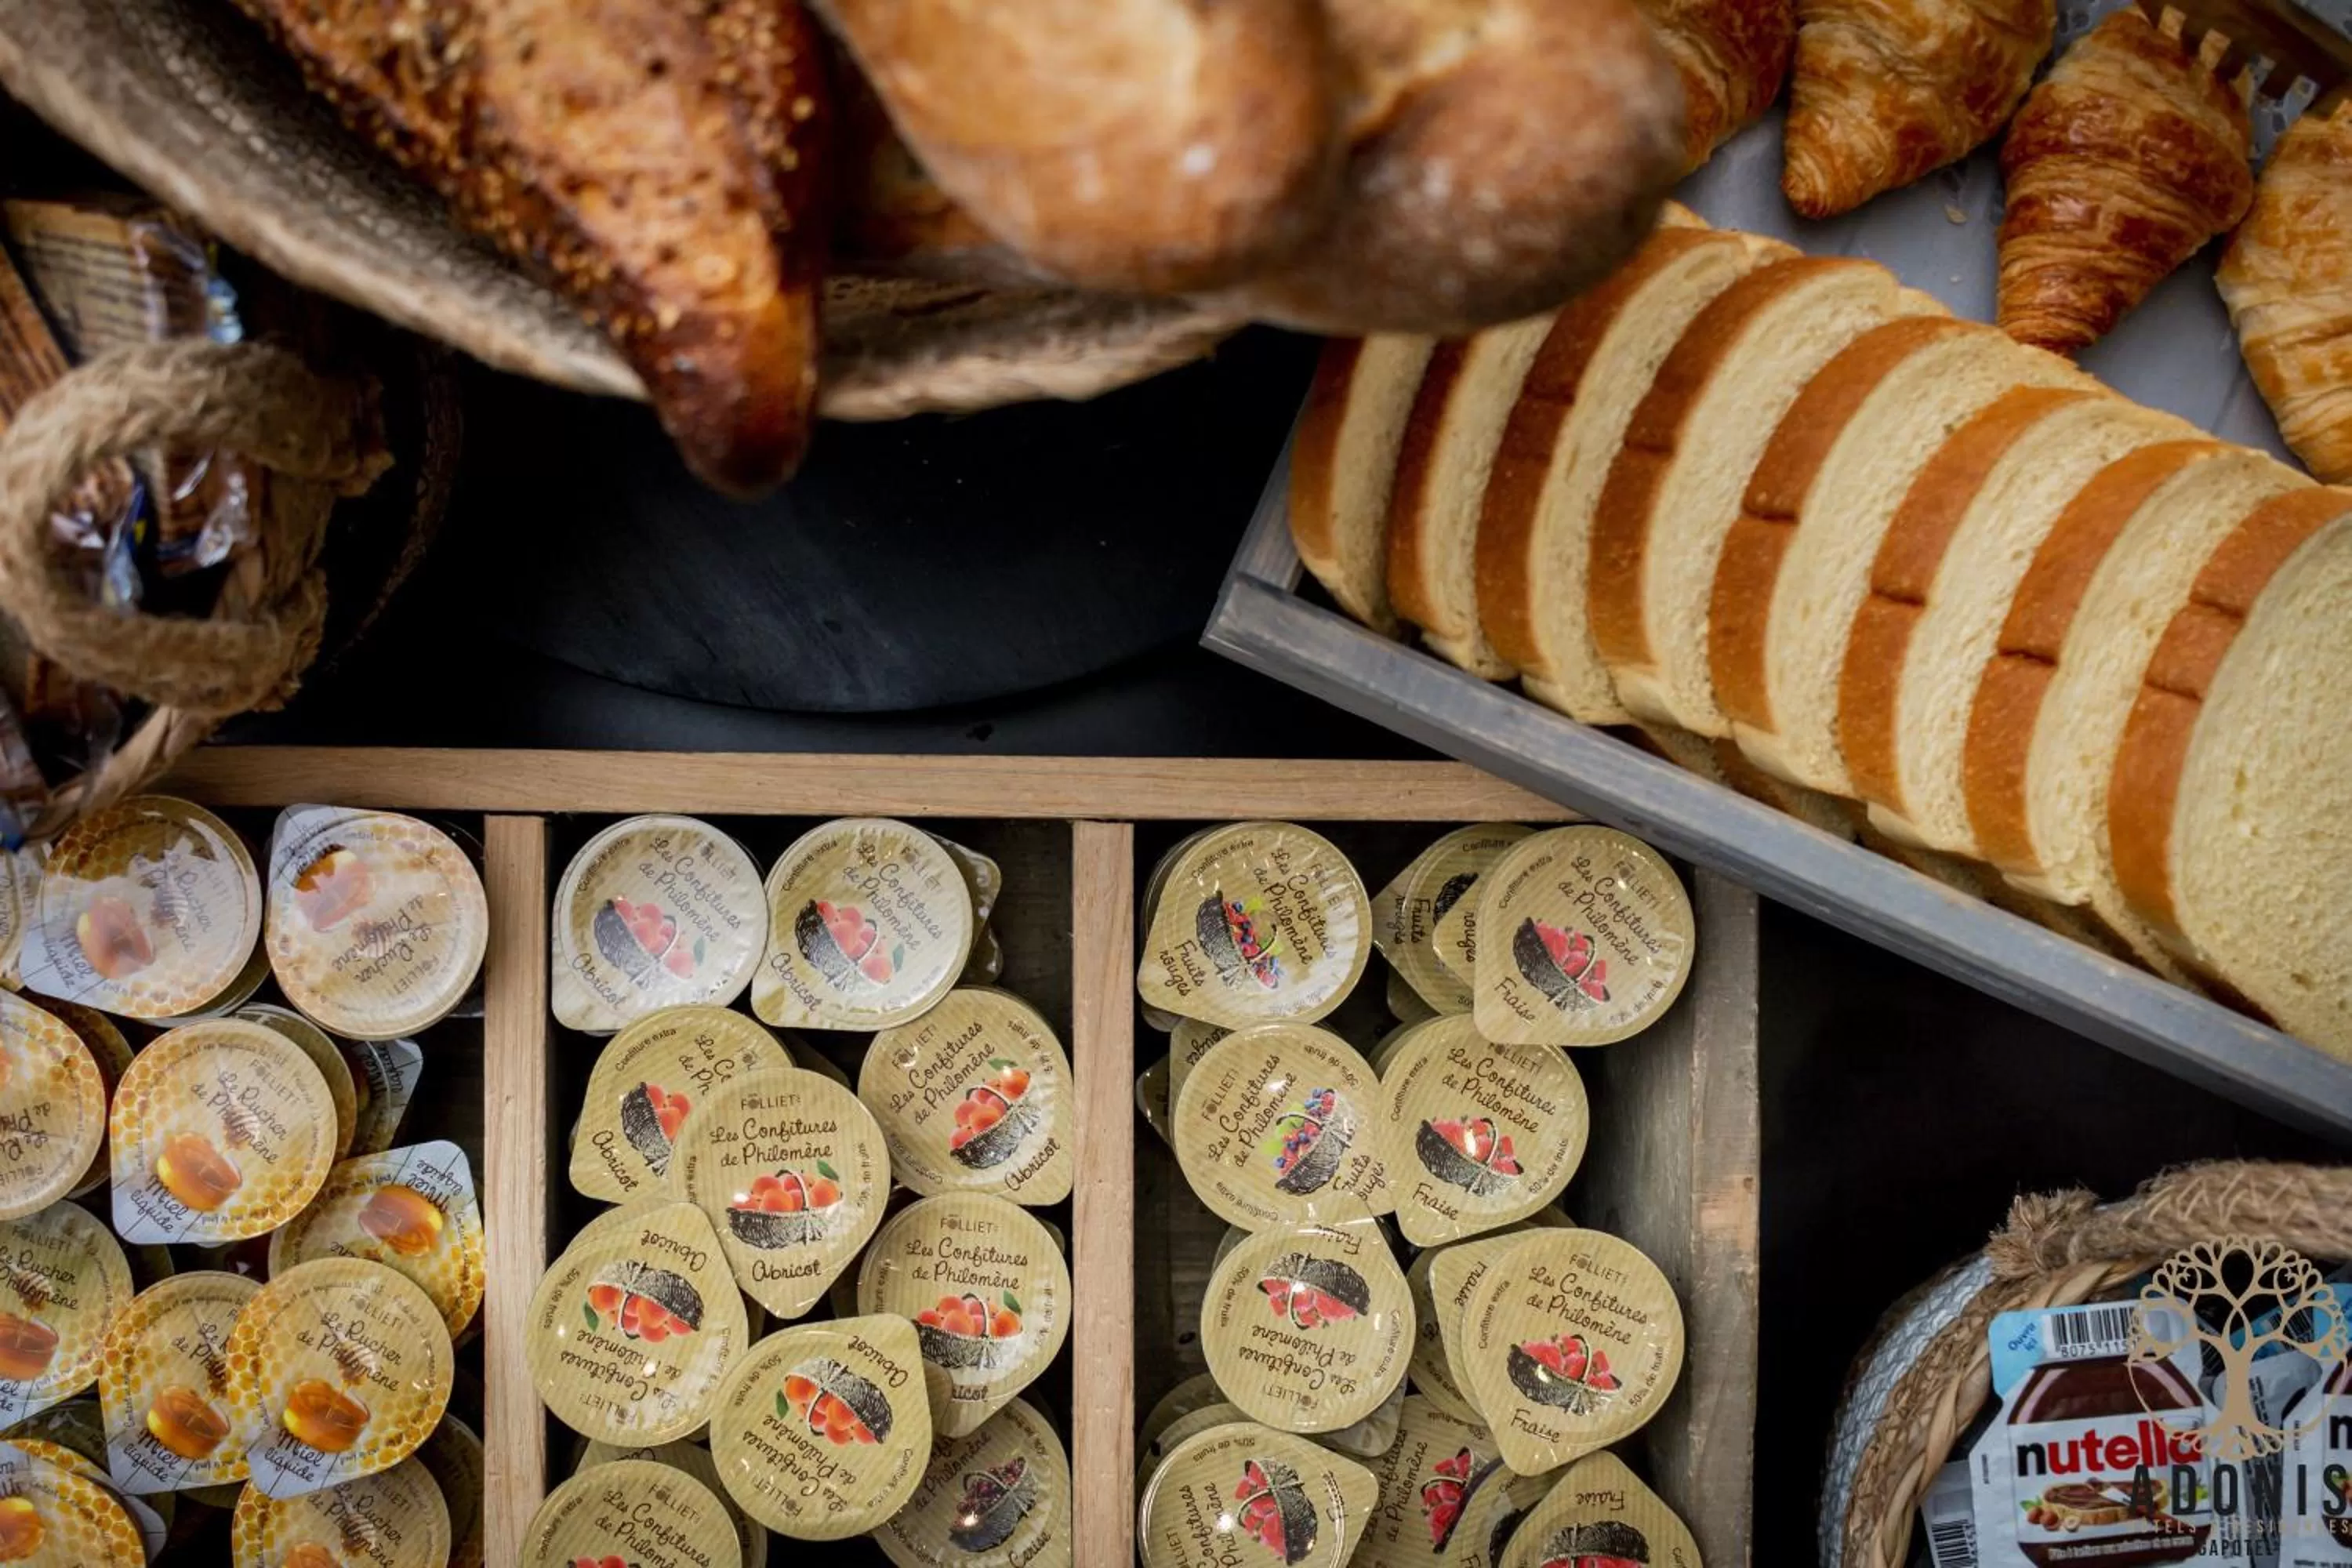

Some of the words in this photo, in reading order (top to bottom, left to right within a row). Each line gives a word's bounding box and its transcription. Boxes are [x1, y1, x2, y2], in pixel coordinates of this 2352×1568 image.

[1270, 847, 1292, 877] Les
[1498, 870, 1529, 909] Confiture
[1529, 855, 1554, 873] extra
[638, 862, 654, 879] de
[653, 869, 720, 942] Philomène
[650, 837, 673, 864] Les
[674, 856, 741, 930] Confitures
[856, 840, 879, 869] Les
[878, 862, 942, 941] Confitures
[1613, 859, 1654, 907] FOLLIET
[857, 875, 922, 951] Philomène
[1253, 866, 1268, 885] de
[1263, 881, 1314, 965] Philomène
[1557, 881, 1573, 898] de
[1573, 890, 1639, 966] Philomène
[1570, 855, 1593, 884] Les
[1593, 877, 1662, 955] Confitures
[1457, 910, 1477, 964] rouges
[354, 939, 415, 983] Rucher
[572, 952, 629, 1011] Abricot
[1160, 949, 1192, 999] rouges
[1174, 938, 1206, 988] Fruits
[771, 952, 822, 1014] Abricot
[1494, 976, 1538, 1022] Fraise
[615, 1037, 652, 1073] Confiture
[652, 1027, 677, 1044] extra
[678, 1054, 695, 1073] de
[694, 1032, 717, 1062] Les
[890, 1088, 915, 1115] Les
[908, 1020, 984, 1090] Confitures
[1303, 1043, 1327, 1062] fruits
[1327, 1057, 1341, 1068] de
[191, 1083, 208, 1101] de
[740, 1093, 793, 1111] FOLLIET
[914, 1108, 931, 1126] de
[924, 1042, 996, 1111] Philomène
[1203, 1069, 1236, 1121] FOLLIET
[1390, 1077, 1411, 1123] Confiture
[1410, 1057, 1429, 1079] extra
[1446, 1047, 1473, 1070] Les
[1475, 1058, 1556, 1117] Confitures
[237, 1086, 288, 1142] Rucher
[1207, 1137, 1231, 1163] Les
[1219, 1054, 1281, 1133] Confitures
[1237, 1071, 1298, 1149] Philomène
[1441, 1073, 1458, 1091] de
[1460, 1077, 1539, 1134] Philomène
[709, 1125, 741, 1147] Les
[742, 1117, 839, 1142] Confitures
[591, 1129, 640, 1193] Abricot
[684, 1154, 698, 1181] extra
[720, 1152, 739, 1168] de
[742, 1142, 834, 1166] Philomène
[1004, 1137, 1062, 1192] Abricot
[1233, 1149, 1250, 1168] de
[129, 1188, 176, 1234] liquide
[145, 1174, 190, 1221] Miel
[1412, 1181, 1460, 1221] Fraise
[940, 1214, 992, 1234] FOLLIET
[17, 1250, 77, 1286] Rucher
[640, 1229, 707, 1272] Abricot
[751, 1258, 823, 1283] Abricot
[905, 1240, 935, 1258] Les
[938, 1236, 1029, 1268] Confitures
[1569, 1253, 1620, 1284] FOLLIET
[564, 1269, 581, 1290] 50%
[912, 1266, 930, 1280] de
[933, 1260, 1021, 1290] Philomène
[1227, 1287, 1238, 1301] de
[1231, 1265, 1250, 1287] 50%
[1528, 1265, 1555, 1288] Les
[1559, 1272, 1648, 1325] Confitures
[543, 1305, 557, 1330] fruits
[554, 1290, 565, 1305] de
[1220, 1301, 1232, 1328] fruits
[1478, 1301, 1497, 1350] Confiture
[1491, 1279, 1512, 1302] extra
[296, 1330, 314, 1347] de
[1526, 1294, 1544, 1309] de
[1545, 1294, 1633, 1345] Philomène
[171, 1334, 190, 1353] de
[345, 1319, 402, 1367] Rucher
[760, 1354, 782, 1373] 50%
[848, 1335, 909, 1388] Abricot
[1251, 1325, 1335, 1368] Philomène
[1338, 1349, 1356, 1367] de
[2060, 1344, 2097, 1359] 8075
[560, 1349, 649, 1402] Confitures
[664, 1365, 682, 1381] de
[748, 1372, 760, 1385] de
[1239, 1345, 1326, 1392] Confitures
[1330, 1374, 1357, 1396] Les
[734, 1384, 753, 1407] fruits
[1266, 1384, 1320, 1410] FOLLIET
[1216, 1439, 1231, 1450] de
[1232, 1437, 1257, 1448] 50%
[1509, 1407, 1563, 1444] Fraise
[122, 1443, 169, 1483] liquide
[136, 1427, 182, 1470] Miel
[263, 1446, 314, 1483] liquide
[277, 1428, 326, 1469] Miel
[742, 1429, 821, 1497] Confitures
[763, 1414, 839, 1479] Philomène
[1191, 1446, 1217, 1464] fruits
[2016, 1420, 2201, 1478] nutella
[840, 1468, 857, 1486] de
[1384, 1441, 1428, 1523] Philomène
[649, 1483, 695, 1521] FOLLIET
[822, 1486, 849, 1513] Les
[1575, 1490, 1625, 1512] Fraise
[354, 1494, 403, 1547] Rucher
[595, 1515, 613, 1531] de
[603, 1490, 629, 1513] Les
[633, 1503, 713, 1568] Confitures
[1007, 1530, 1053, 1567] Cerise
